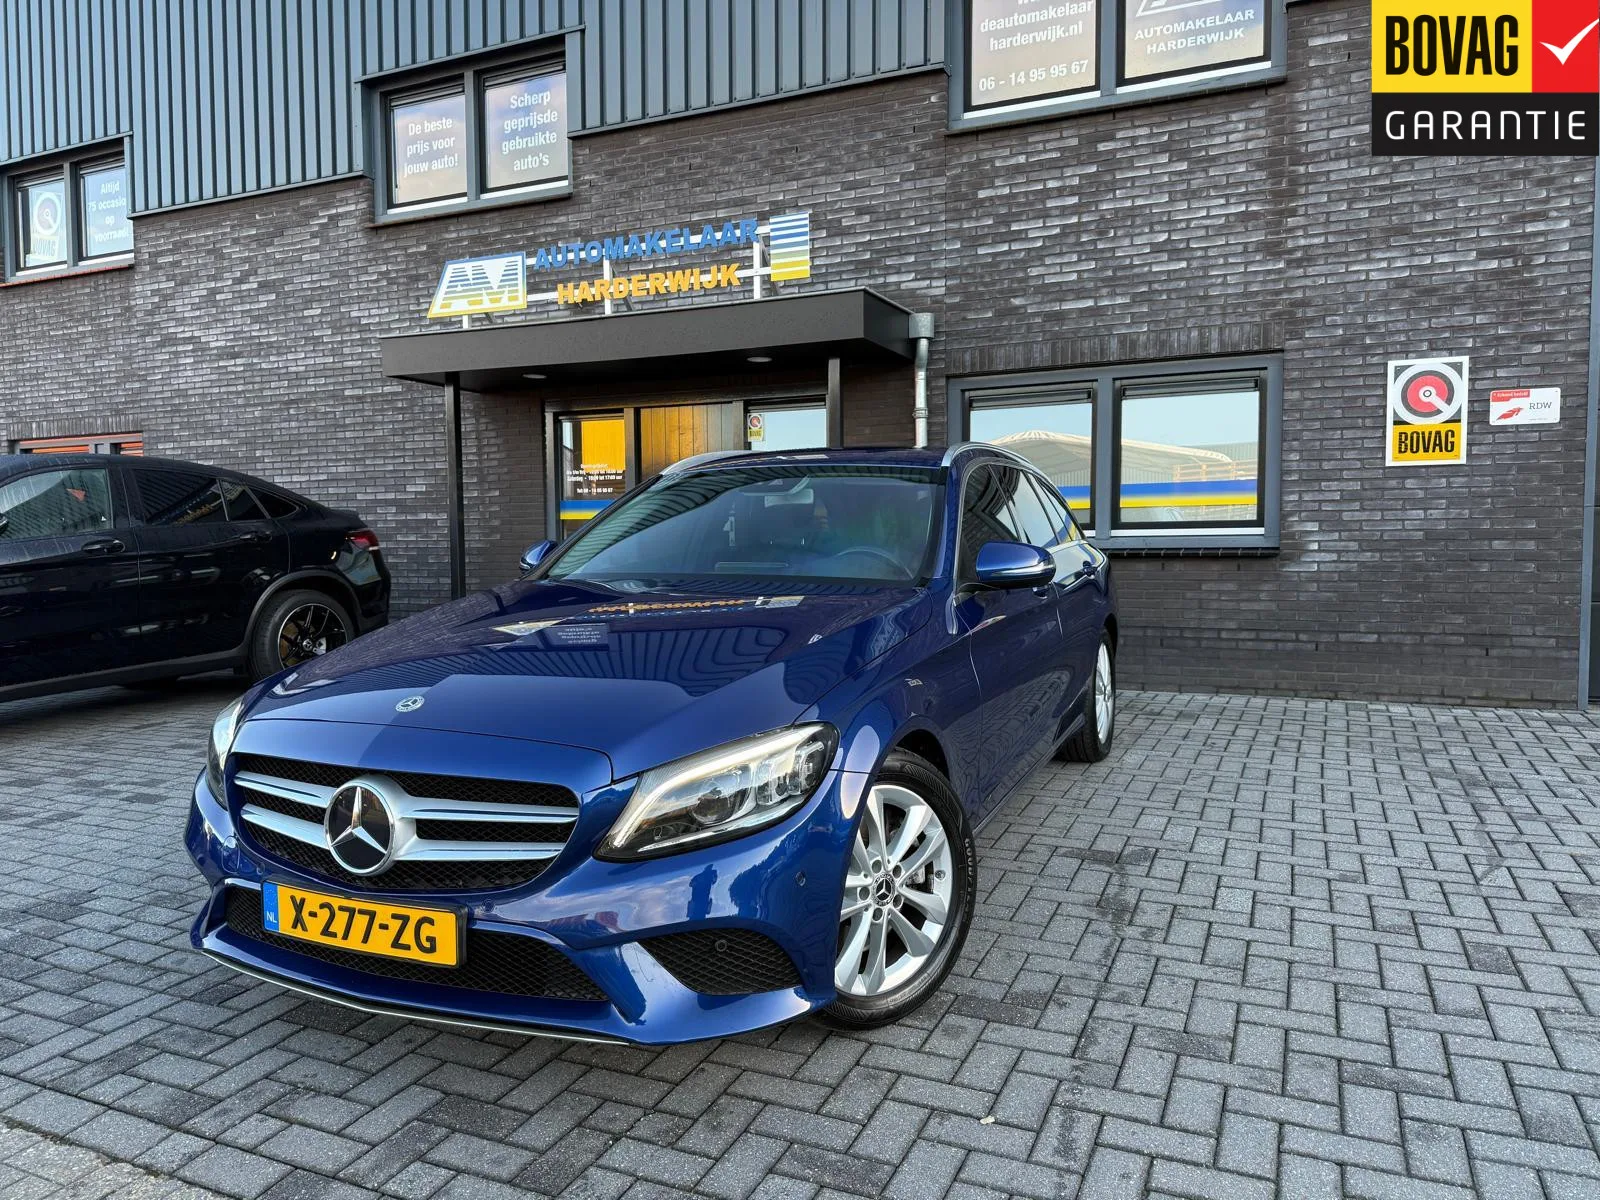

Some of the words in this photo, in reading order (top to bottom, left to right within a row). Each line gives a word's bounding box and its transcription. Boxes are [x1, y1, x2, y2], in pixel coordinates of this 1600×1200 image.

[980, 0, 1094, 33] deautomakelaar
[1134, 9, 1255, 40] AUTOMAKELAAR
[989, 20, 1083, 51] harderwijk.nl
[1146, 28, 1245, 54] HARDERWIJK
[979, 76, 995, 91] 06
[1009, 71, 1025, 86] 14
[1029, 68, 1046, 81] 95
[1050, 64, 1067, 78] 95
[1071, 59, 1089, 74] 67
[510, 90, 551, 109] Scherp
[408, 123, 422, 136] De
[424, 117, 453, 133] beste
[504, 109, 558, 133] geprijsde
[406, 141, 429, 158] prijs
[432, 137, 456, 150] voor
[502, 131, 557, 155] gebruikte
[403, 160, 429, 178] jouw
[431, 153, 459, 170] auto!
[534, 218, 759, 271] AUTOMAKELAAR
[556, 263, 742, 305] HARDERWIJK
[1529, 401, 1552, 410] RDW
[1398, 429, 1455, 454] BOVAG
[266, 910, 278, 923] NL
[290, 894, 437, 954] X-277-ZG
